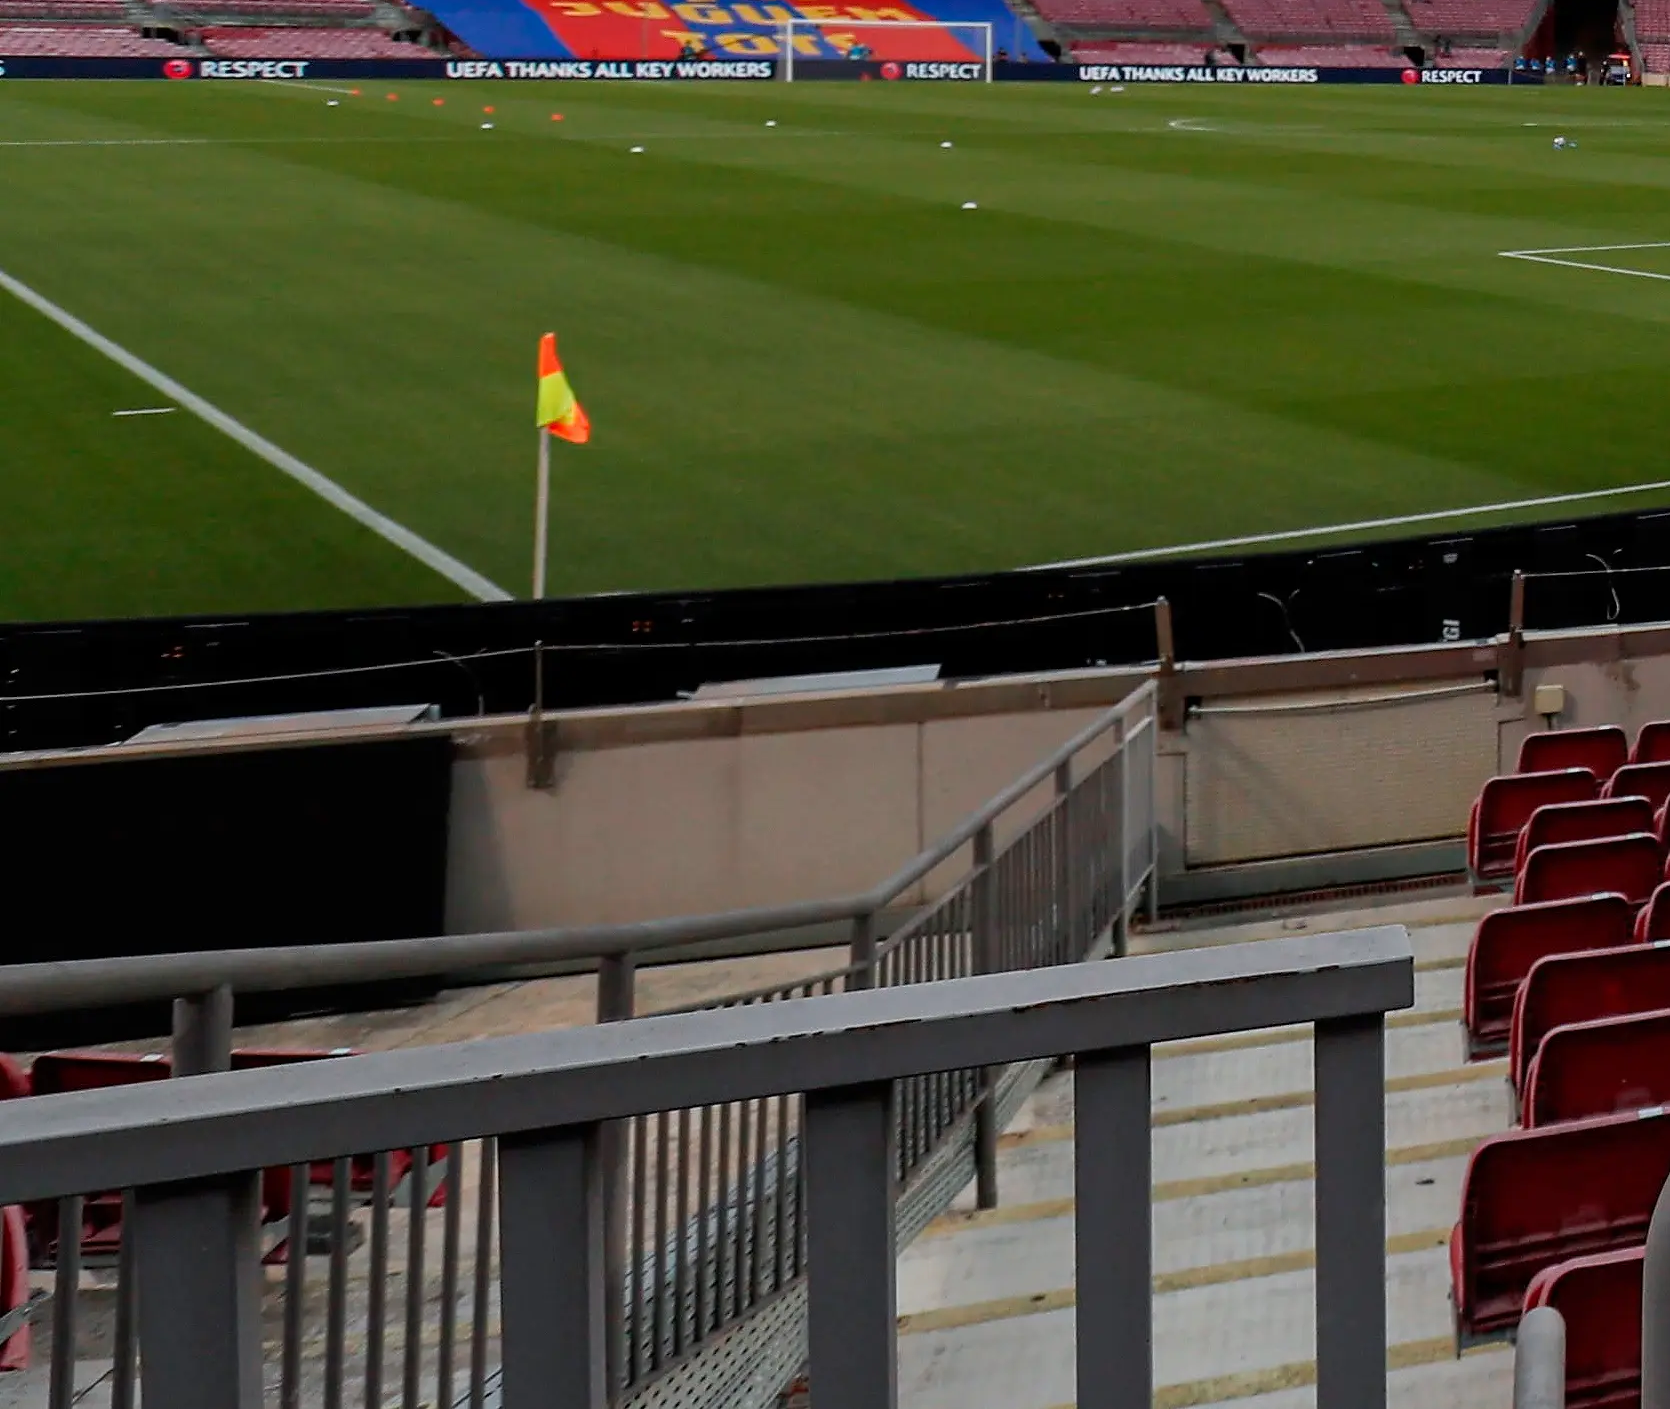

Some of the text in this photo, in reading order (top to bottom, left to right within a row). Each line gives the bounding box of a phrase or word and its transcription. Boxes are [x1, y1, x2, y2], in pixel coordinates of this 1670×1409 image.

[200, 61, 310, 78] RESPECT
[446, 61, 773, 79] UEFA THANKS ALL KEY WORKERS
[906, 63, 982, 79] RESPECT
[1079, 66, 1318, 82] UEFA THANKS ALL KEY WORKERS
[1421, 69, 1482, 83] RESPECT
[1442, 619, 1460, 641] GI
